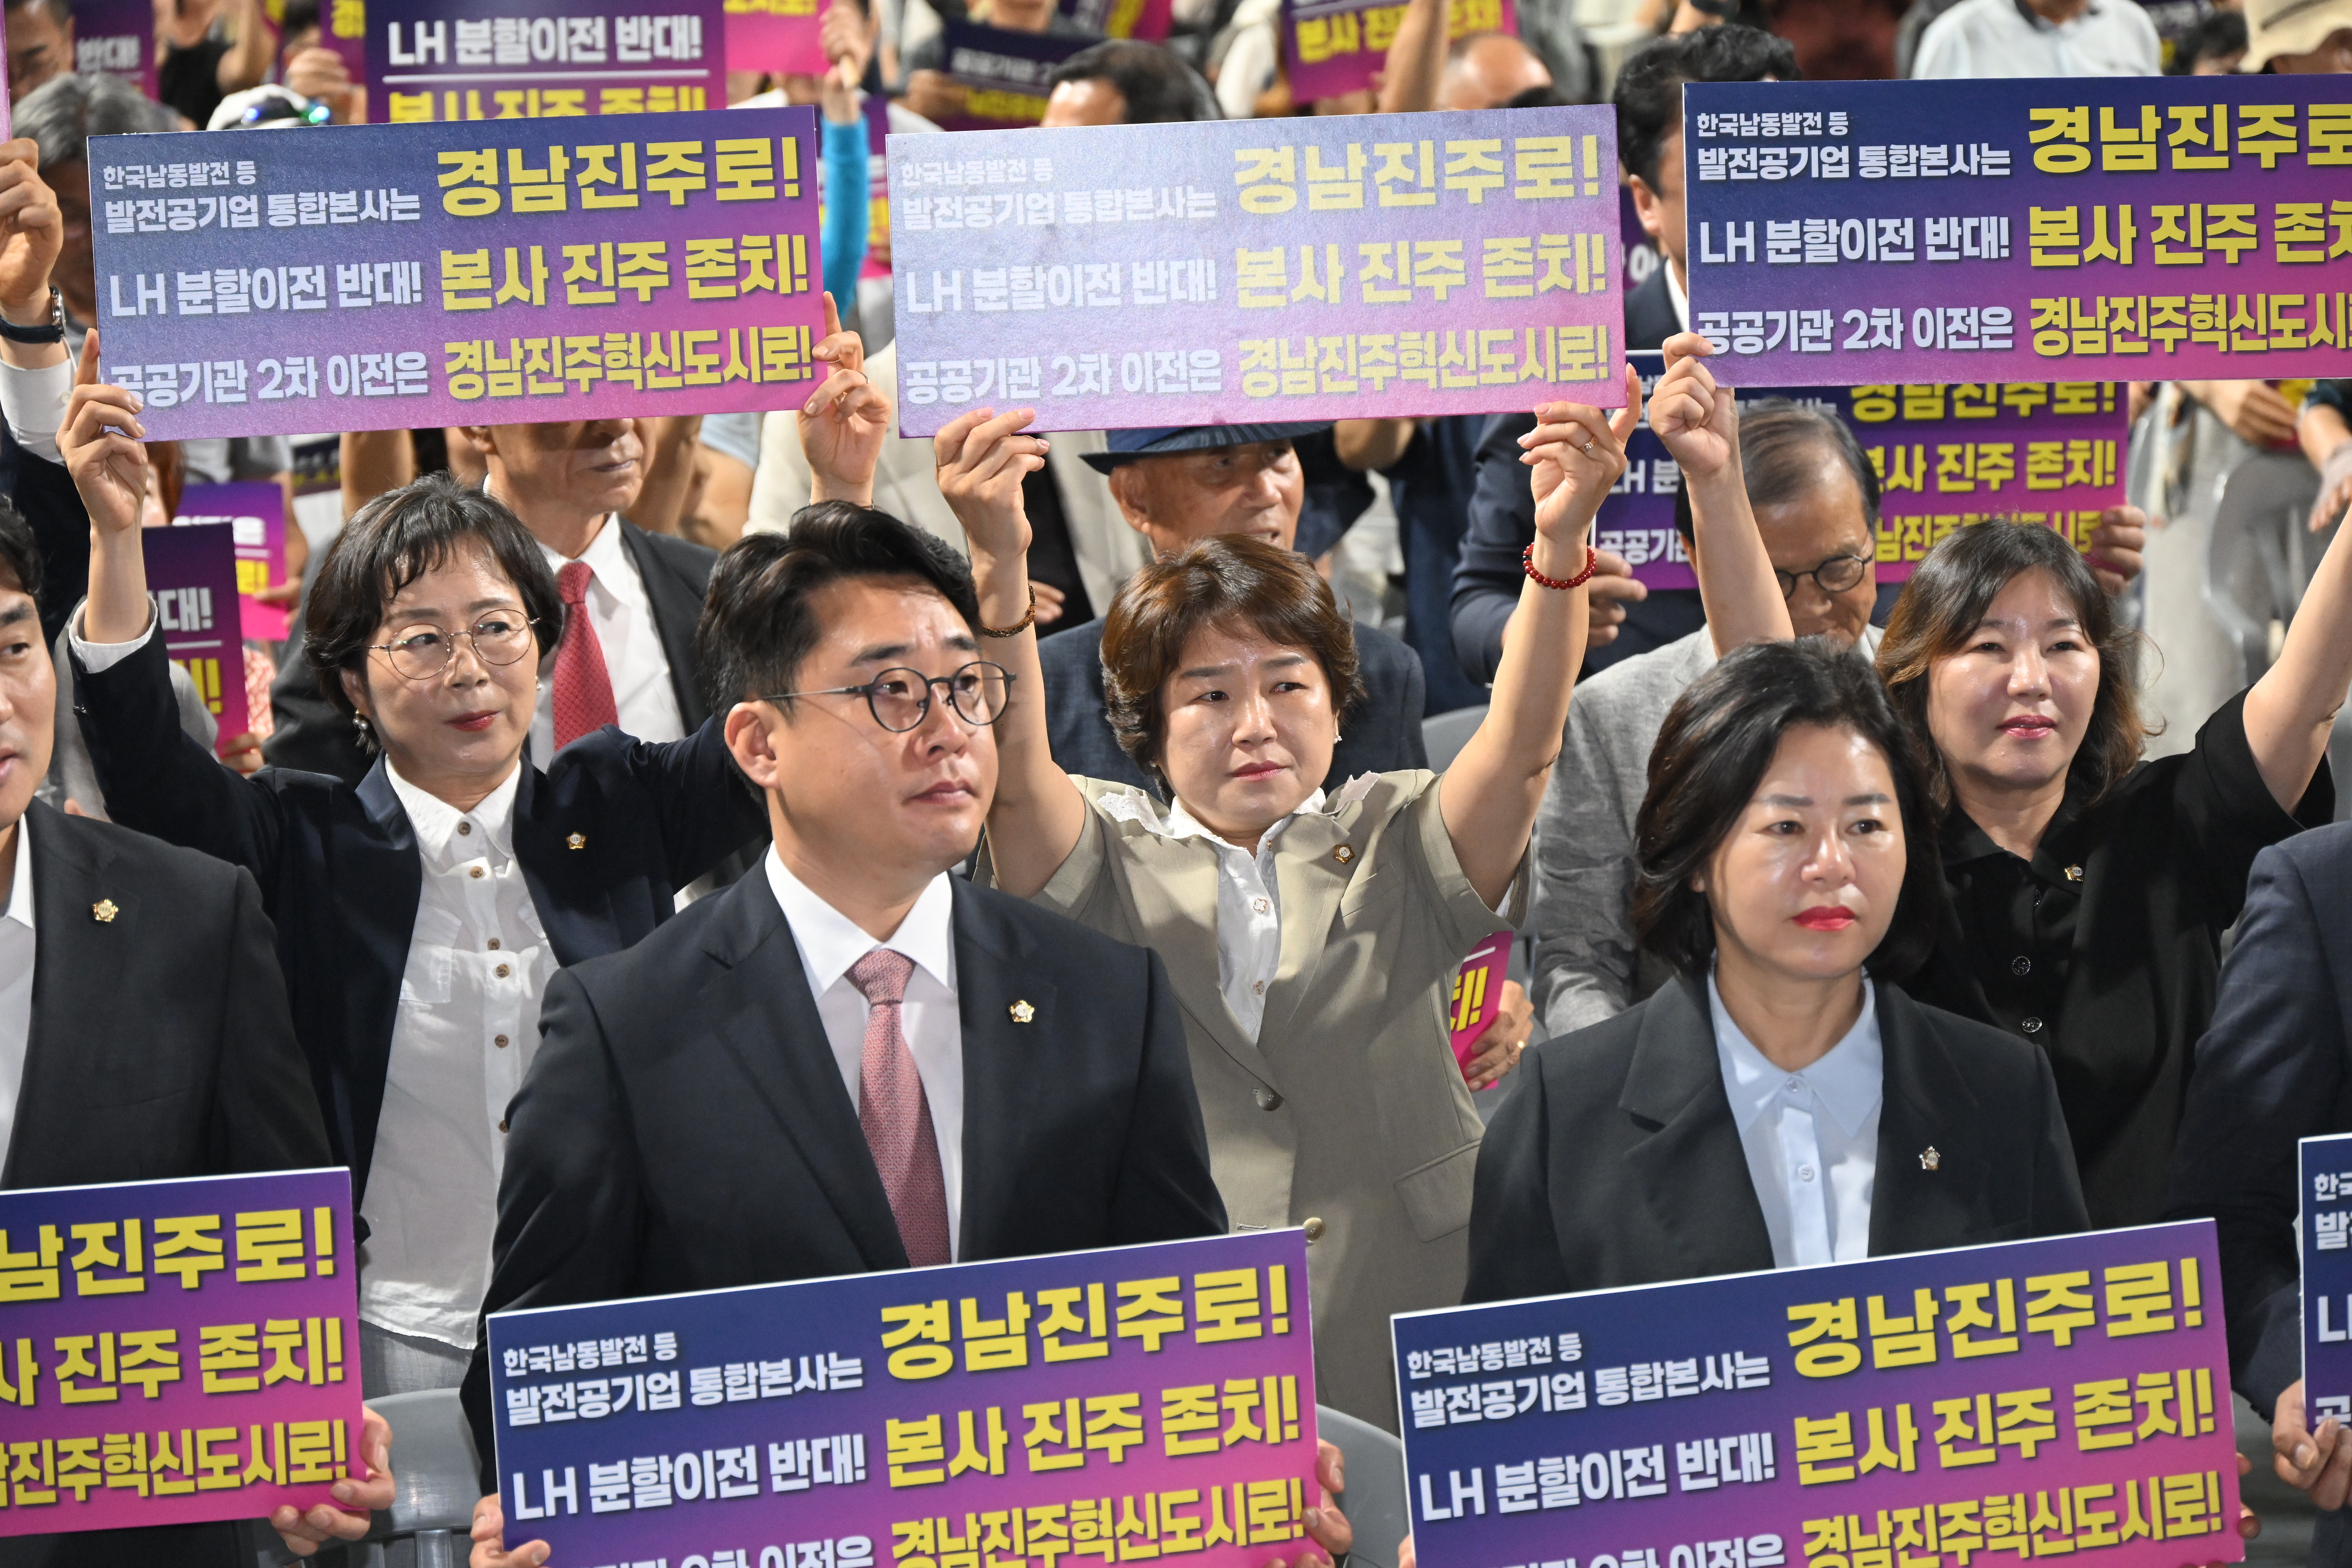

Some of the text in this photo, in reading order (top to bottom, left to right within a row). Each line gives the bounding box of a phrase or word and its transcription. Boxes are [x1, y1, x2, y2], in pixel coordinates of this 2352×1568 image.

[389, 15, 703, 66] LH 분할이전 반대!
[1697, 112, 1848, 137] 한국남동발전 등
[103, 161, 256, 190] 한국남동발전 등
[437, 136, 799, 217] 경남진주로!
[902, 158, 1027, 186] 한국남동발전
[1034, 157, 1052, 181] 등
[1235, 135, 1598, 215] 경남진주로!
[1698, 143, 2010, 180] 발전공기업 통합본사는
[105, 187, 420, 233] 발전공기업 통합본사는
[903, 191, 1054, 229] 발전공기업
[1064, 186, 1216, 223] 통합본사는
[2030, 204, 2137, 267] 본사
[2151, 203, 2257, 264] 진주
[1236, 243, 1345, 308] 본사
[1359, 239, 1466, 303] 진주
[1483, 233, 1606, 299] 존치!
[1700, 221, 1754, 263] LH
[1766, 218, 1914, 262] 분할이전
[1925, 217, 2009, 260] 반대!
[110, 261, 422, 317] LH 분할이전 반대!
[440, 234, 808, 311] 본사 진주 존치!
[906, 260, 1216, 313] LH 분할이전 반대!
[1698, 306, 2012, 354] 공공기관 2차 이전은
[2030, 293, 2352, 356] 경남진주혁신도시
[111, 351, 428, 407] 공공기관 2차 이전은
[444, 325, 811, 400] 경남진주혁신도시로!
[906, 349, 1222, 404] 공공기관 2차 이전은
[1239, 325, 1608, 398] 경남진주혁신도시로!
[1937, 442, 2015, 492] 진주
[2027, 439, 2116, 490] 존치!
[157, 587, 213, 632] 대!
[881, 1265, 1289, 1379] 경남진주로!
[1787, 1257, 2202, 1378] 경남진주로!
[2318, 1294, 2352, 1343] L
[55, 1329, 180, 1404] 진주
[199, 1317, 344, 1394] 존치!
[503, 1332, 677, 1377] 한국남동발전 등
[1407, 1333, 1582, 1379] 한국남동발전 등
[505, 1352, 863, 1427] 발전공기업 통합본사는
[1412, 1351, 1770, 1428] 발전공기업 통합본사는
[886, 1375, 1300, 1488] 본사 진주 존치!
[1794, 1367, 2215, 1486] 본사 진주 존치!
[0, 1419, 346, 1507] 진주혁신도시로!
[513, 1434, 866, 1521] LH 분할이전 반대!
[1420, 1432, 1775, 1521] LH 분할이전 반대!
[891, 1477, 1304, 1568] 경남진주혁신도시로!
[1802, 1471, 2222, 1568] 경남진주혁신도시로!
